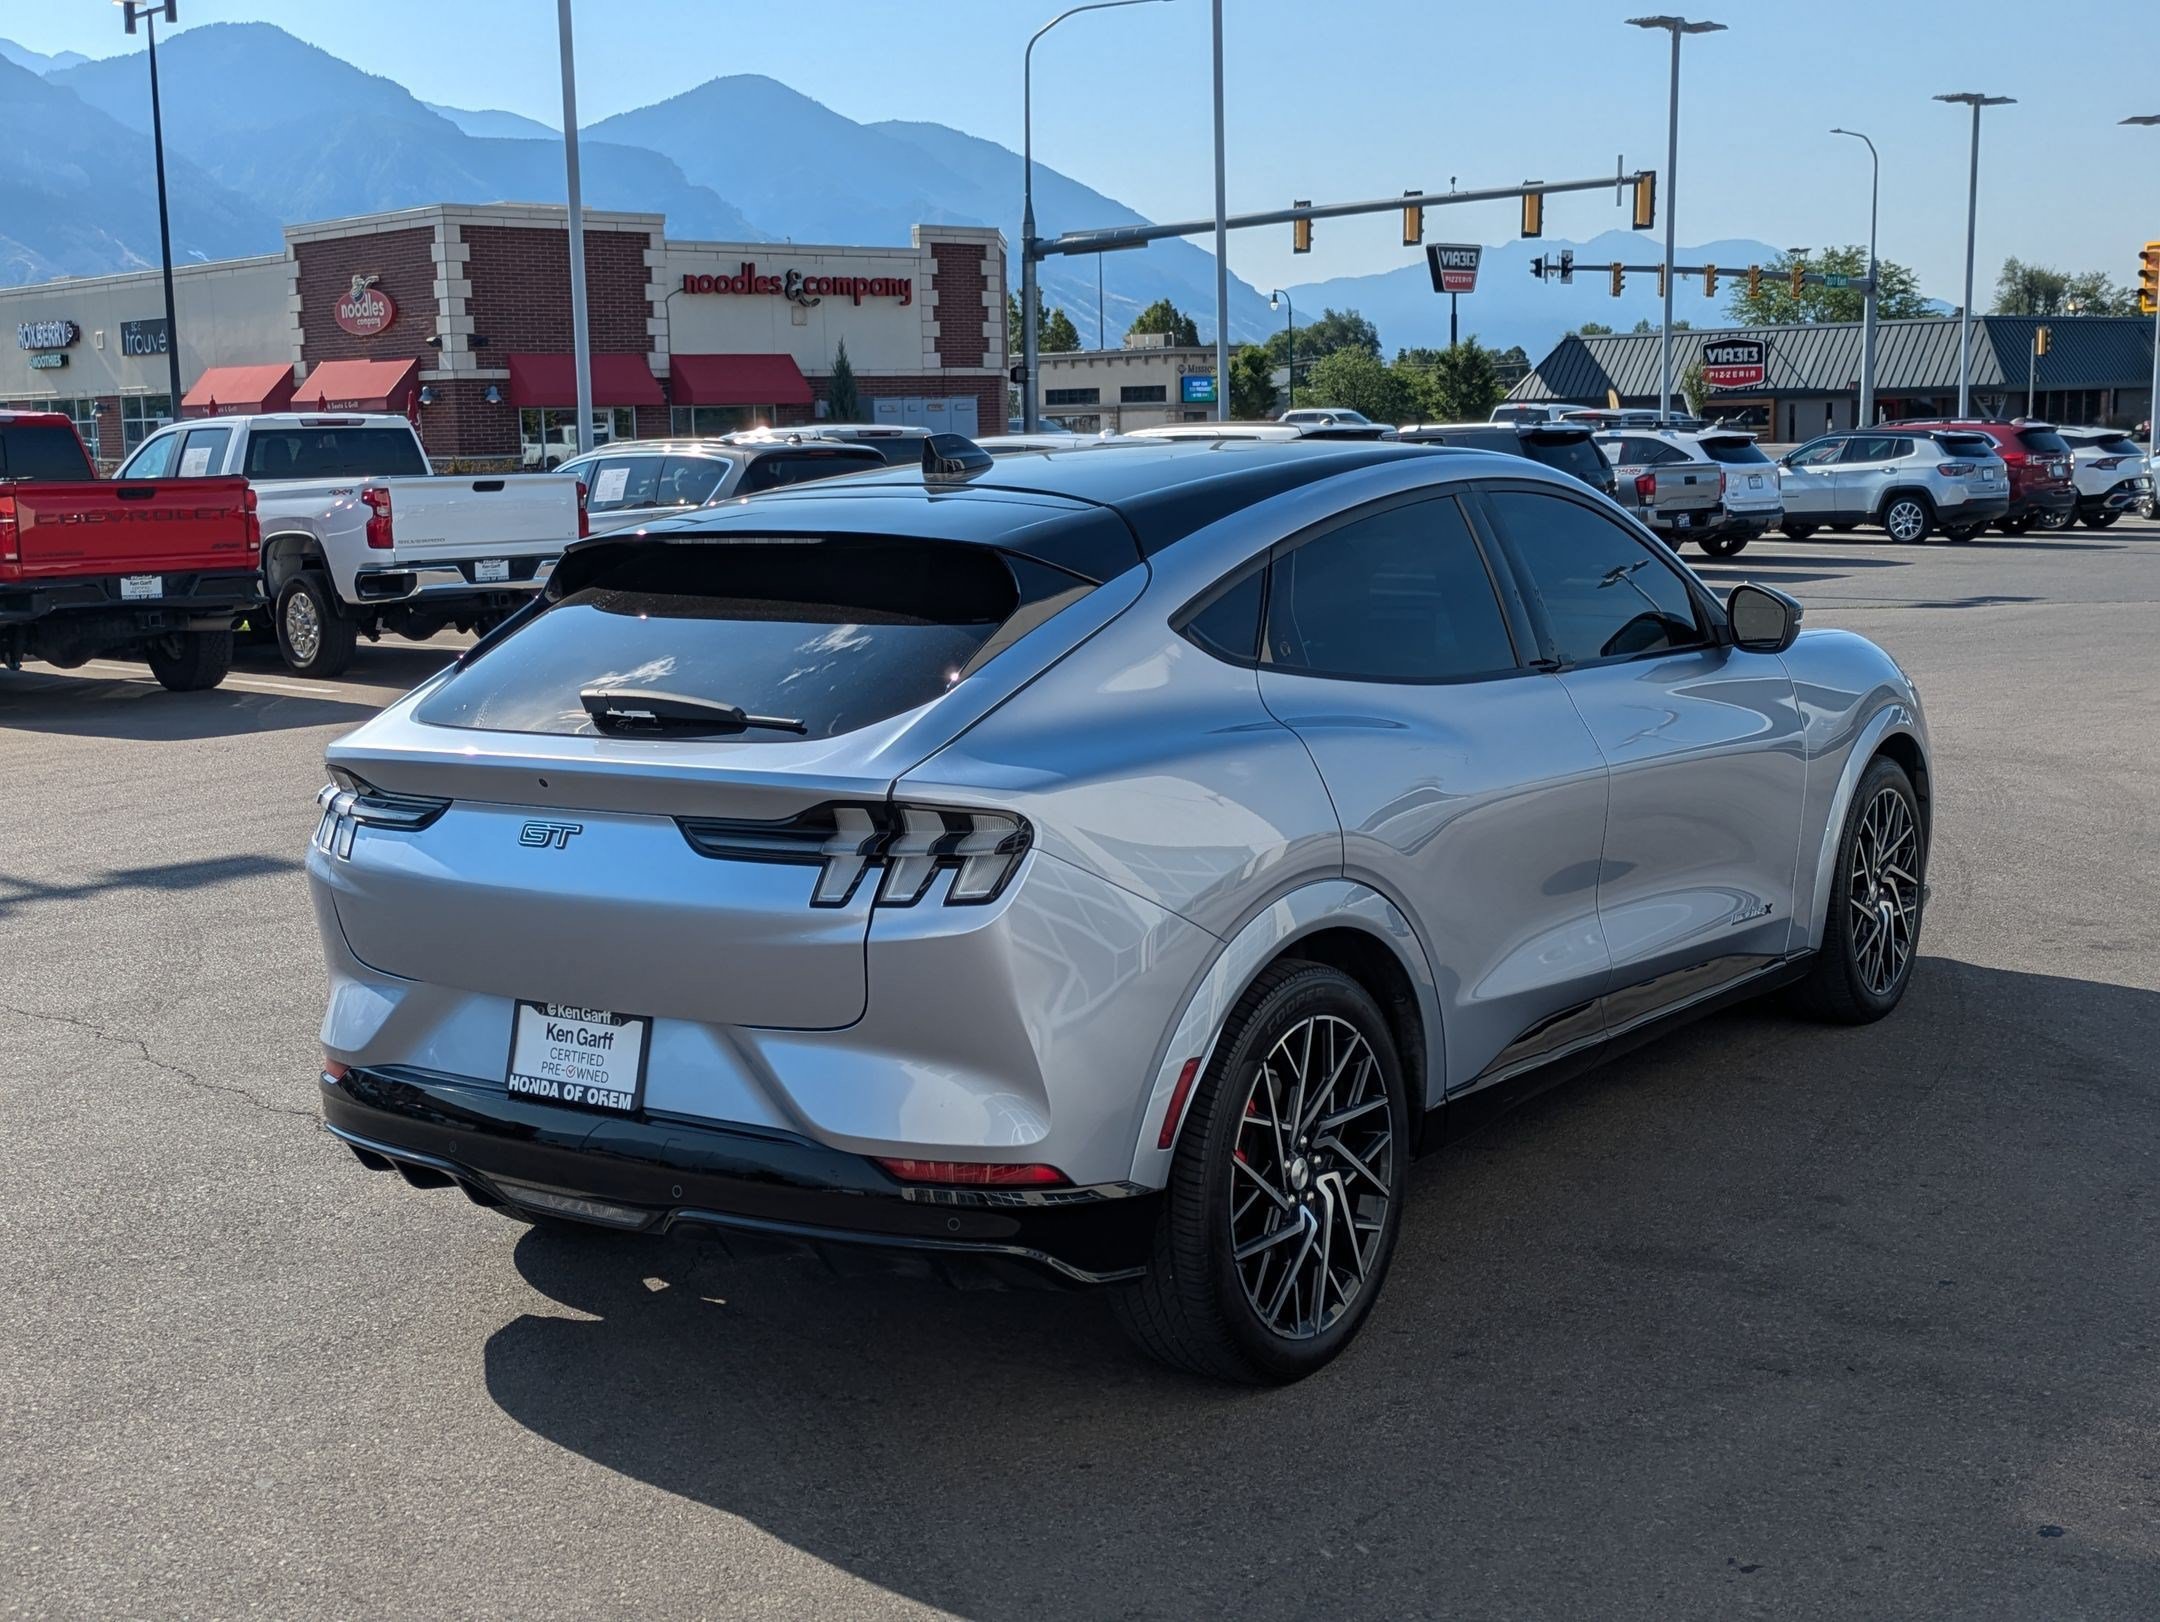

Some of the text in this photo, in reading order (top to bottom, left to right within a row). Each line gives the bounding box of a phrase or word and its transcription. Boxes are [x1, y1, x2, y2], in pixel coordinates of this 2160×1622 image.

[1440, 250, 1477, 267] VIA313
[1444, 275, 1473, 284] PIZZERIA
[340, 292, 385, 319] noodles
[356, 317, 381, 328] company
[17, 322, 66, 349] ROXBERRY
[125, 329, 167, 355] trouvé
[29, 354, 63, 369] SMOOTHIES
[1705, 347, 1759, 363] VIA313
[1708, 370, 1757, 379] PIZZERIA
[34, 507, 230, 526] CHEVROLET
[518, 820, 583, 850] GT
[557, 1003, 612, 1025] Ken Garff
[545, 1021, 615, 1051] Ken Garff
[549, 1046, 605, 1068] CERTIFIED
[508, 1074, 632, 1110] HONDA OF OREM
